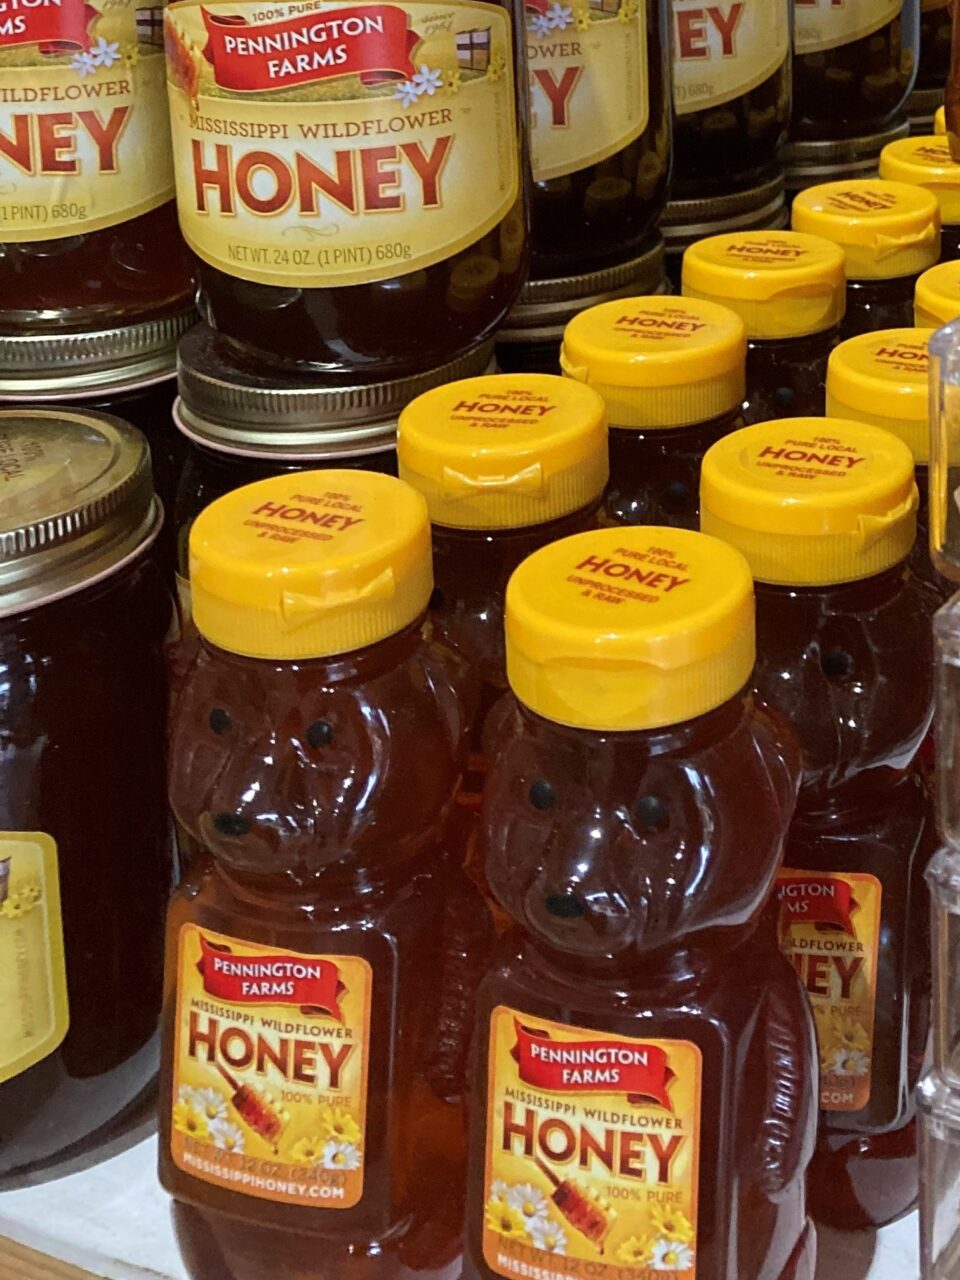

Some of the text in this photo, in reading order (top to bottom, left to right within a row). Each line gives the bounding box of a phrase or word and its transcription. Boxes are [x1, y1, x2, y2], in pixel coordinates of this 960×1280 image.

[252, 0, 323, 23] 100% PURE
[224, 15, 384, 56] PENNINGTON
[267, 44, 348, 79] FARMS
[0, 80, 131, 103] ILDFLOWER
[189, 108, 453, 139] MISSISSIPPI WILDFLOWER
[0, 104, 131, 176] NEY
[191, 133, 455, 217] HONEY
[12, 203, 87, 222] PINT) 680g
[228, 245, 248, 261] NET
[274, 249, 289, 264] 24
[292, 250, 314, 265] OZ.
[334, 247, 372, 265] PINT)
[376, 243, 411, 260] 680g
[726, 245, 808, 257] HONEY
[615, 316, 707, 331] HONEY
[875, 348, 929, 360] HON
[452, 401, 557, 416] HONEY
[758, 446, 866, 468] HONEY
[785, 439, 858, 453] PURE LOCAL
[756, 461, 846, 477] UNPROCESSED
[788, 471, 816, 479] RAW
[252, 501, 365, 531] HONEY
[324, 501, 362, 512] LOCAL
[614, 548, 688, 571] PURE LOCAL
[575, 555, 691, 592] HONEY
[567, 574, 660, 603] UNPROCESSED
[593, 592, 626, 604] RAW
[791, 939, 864, 952] LDFLOWER
[214, 956, 321, 979] PENNINGTON
[242, 981, 295, 996] FARMS
[190, 998, 353, 1039] MISSISSIPPI WILDFLOWER
[188, 1011, 354, 1090] HONEY
[530, 1043, 649, 1066] PENNINGTON
[562, 1069, 620, 1084] FARMS
[280, 1090, 352, 1108] 100% PURE
[505, 1086, 683, 1130] MISSISSIPPI WILDFLOWER
[502, 1101, 686, 1184] HONEY
[183, 1152, 344, 1199] MISSISSIPPIHONEY.COM
[607, 1186, 683, 1204] 100% PURE
